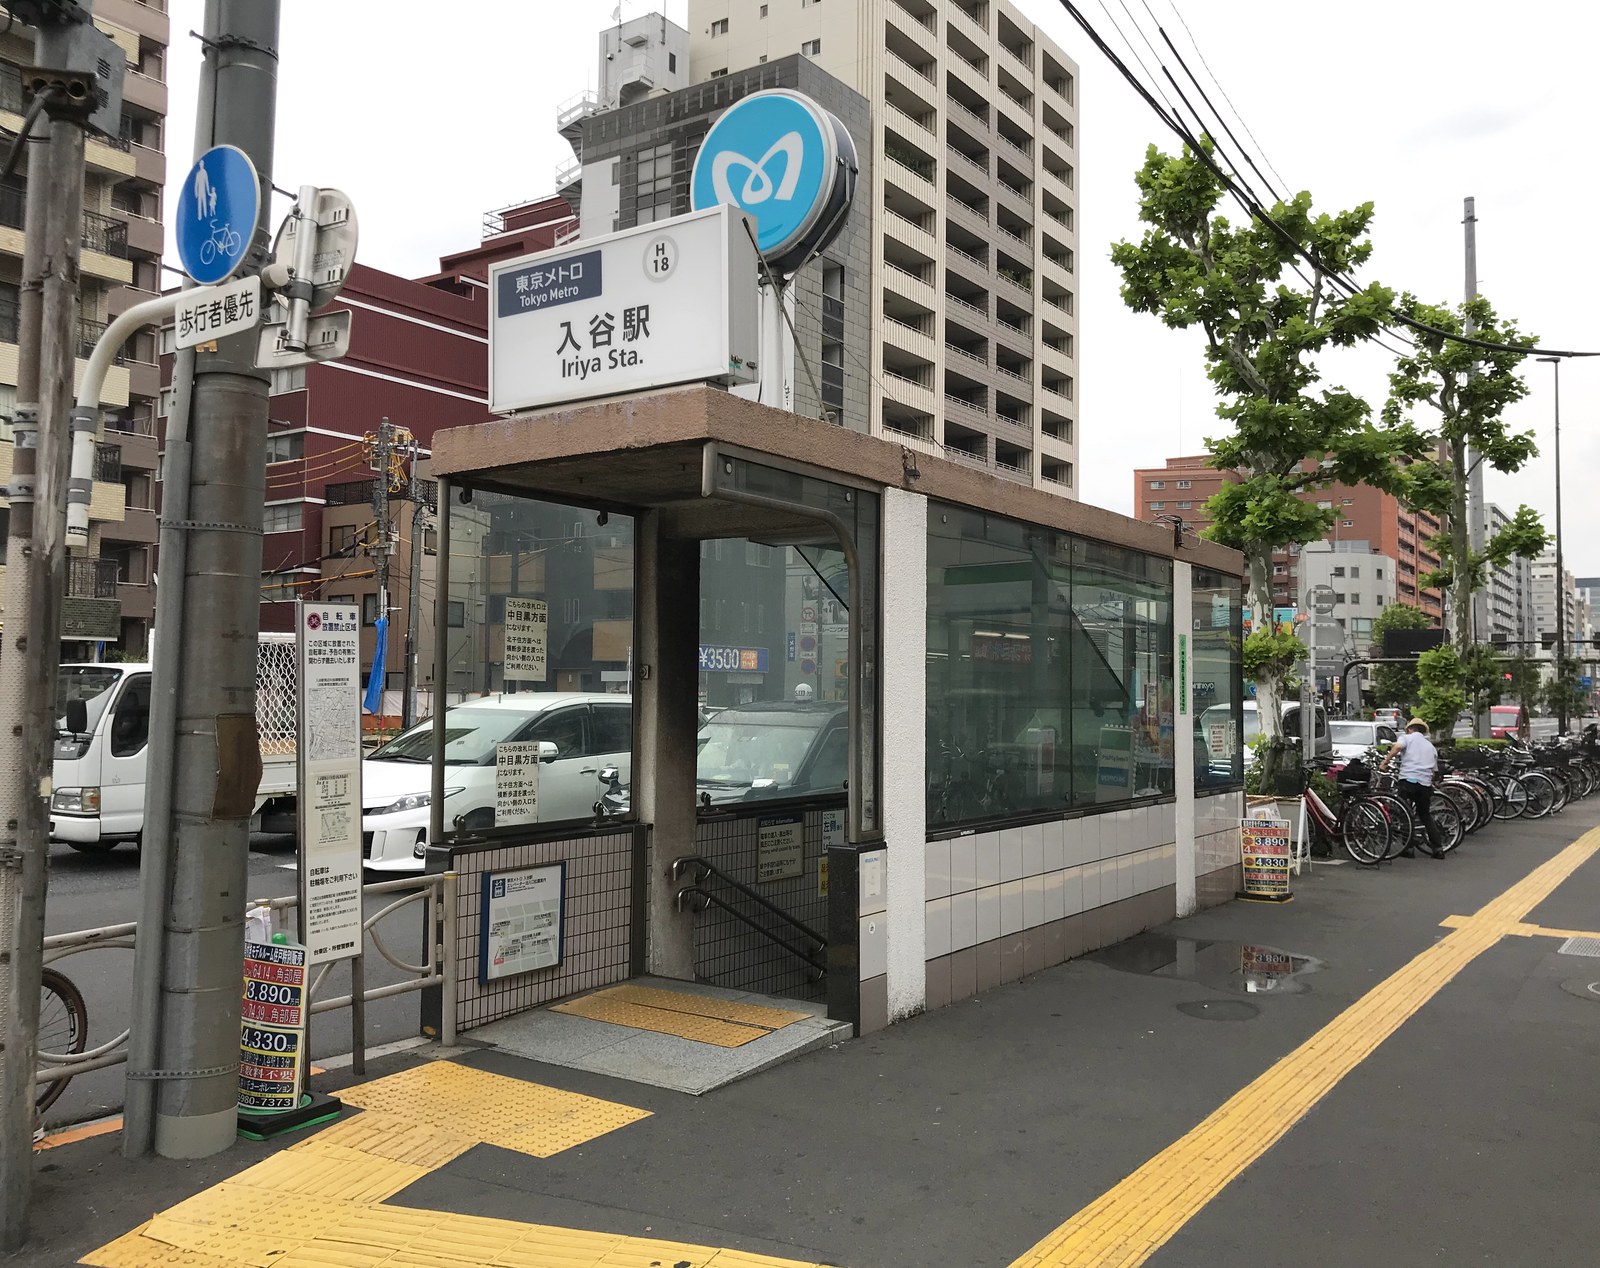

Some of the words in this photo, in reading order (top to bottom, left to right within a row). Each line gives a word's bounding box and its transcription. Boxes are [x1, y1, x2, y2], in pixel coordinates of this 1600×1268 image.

[655, 243, 665, 257] H
[653, 257, 669, 273] 18
[515, 262, 583, 294] 東京メトロ
[520, 291, 548, 308] Tokyo
[549, 285, 579, 301] Metro
[179, 289, 254, 338] 歩行者優先
[556, 304, 651, 356] 入谷駅
[562, 356, 602, 381] Iriya
[608, 349, 644, 370] Sta.
[507, 600, 547, 610] こちらの改札口は
[322, 611, 356, 621] 自転車
[507, 610, 547, 623] 中目黒方面
[322, 622, 357, 632] 放置禁止区域
[506, 623, 534, 633] になります。
[308, 640, 356, 648] この区域に放置された
[506, 635, 542, 645] 北千住方面へは
[308, 648, 356, 656] 自転車は、予告の有無に
[506, 645, 545, 654] 横断歩道を渡った
[506, 653, 545, 663] 向かい側の入口を
[699, 647, 740, 670] ¥3500
[505, 663, 539, 672] ご利用ください。
[498, 754, 538, 766] 中目黒方面
[497, 768, 526, 777] になります。
[497, 781, 533, 789] 北千住方面へは
[497, 789, 536, 798] 横断歩道を渡った
[497, 798, 537, 807] 向かい側の入口を
[497, 807, 531, 817] ご利用ください。
[310, 866, 330, 877] 自転車は
[309, 872, 358, 888] 駐輪場をご利用下さい
[276, 967, 302, 985] 角部屋
[271, 1007, 299, 1025] 角部屋
